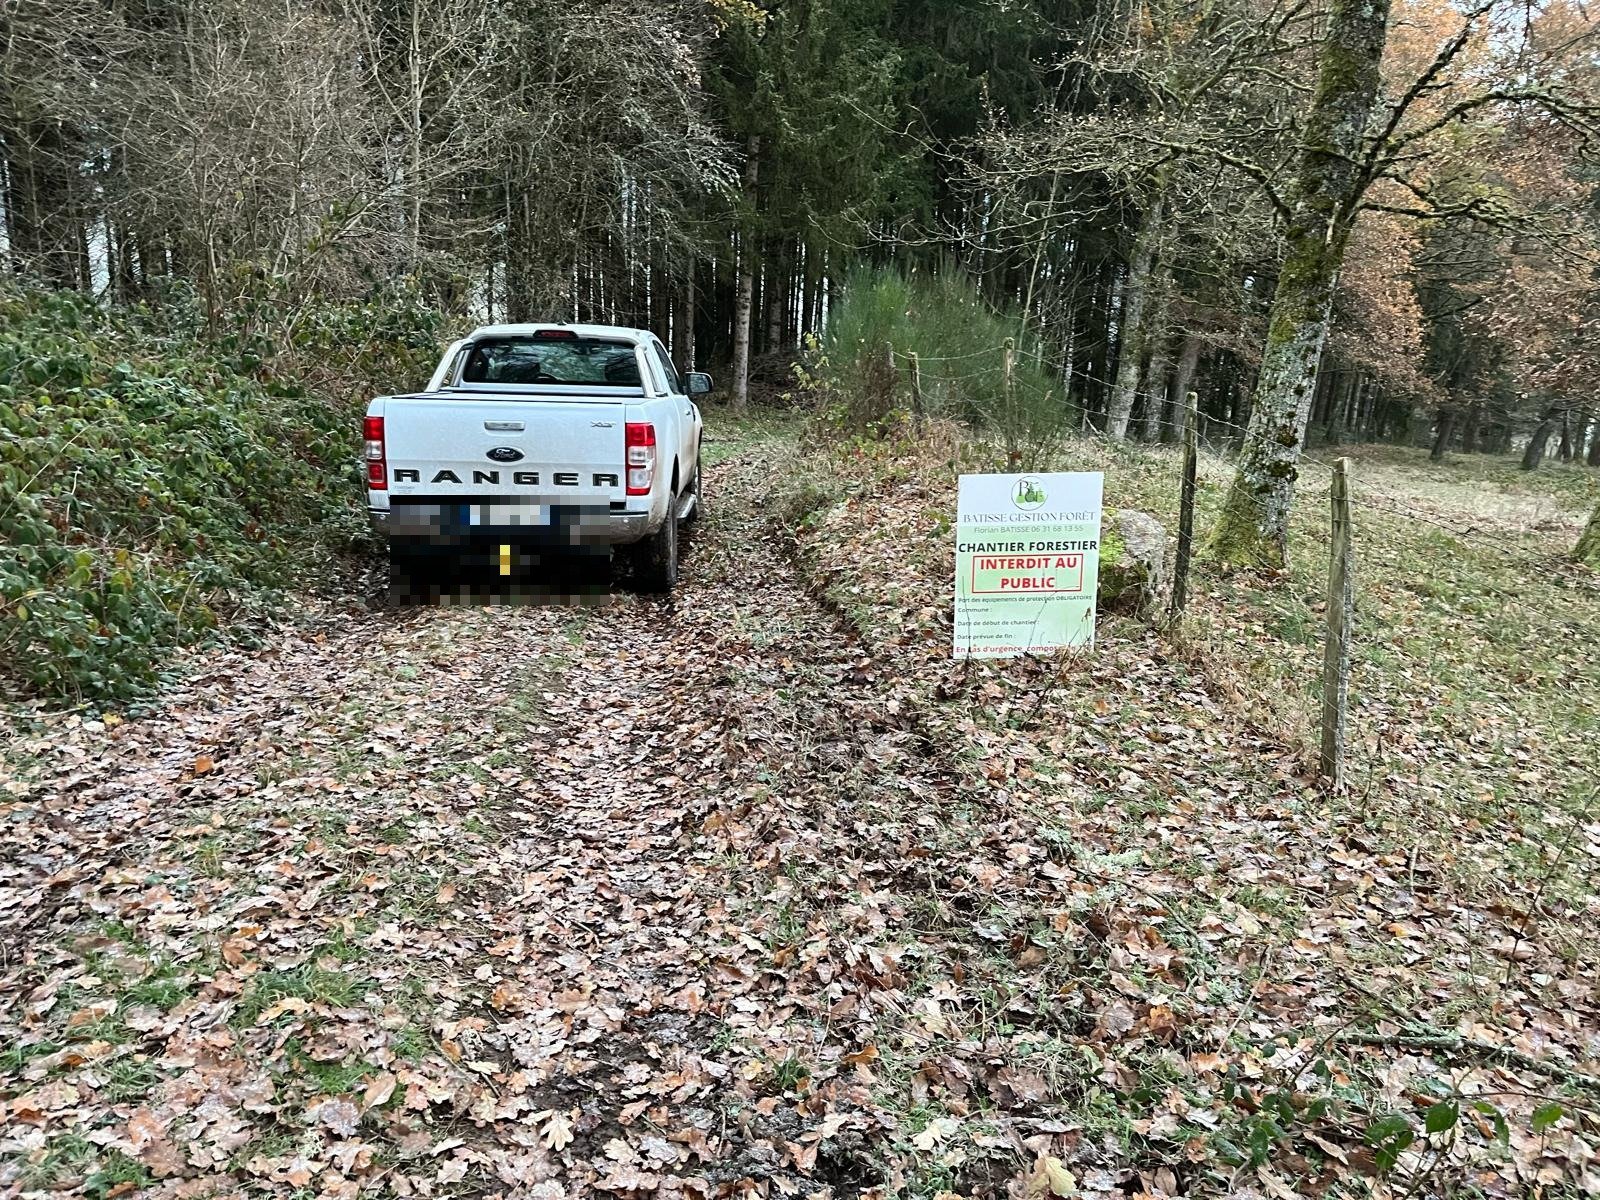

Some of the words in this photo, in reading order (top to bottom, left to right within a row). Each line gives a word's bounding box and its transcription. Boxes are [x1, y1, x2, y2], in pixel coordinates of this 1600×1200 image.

[494, 448, 516, 459] Ford
[393, 469, 619, 487] RANGER
[963, 513, 1007, 523] BATISSE
[1009, 512, 1057, 522] GESTION
[1059, 510, 1096, 521] FORÊT
[958, 542, 1025, 553] CHANTIER
[1029, 540, 1097, 551] FORESTIER
[980, 557, 1051, 570] INTERDIT
[1055, 557, 1077, 568] AU
[1000, 577, 1055, 588] PUBLIC
